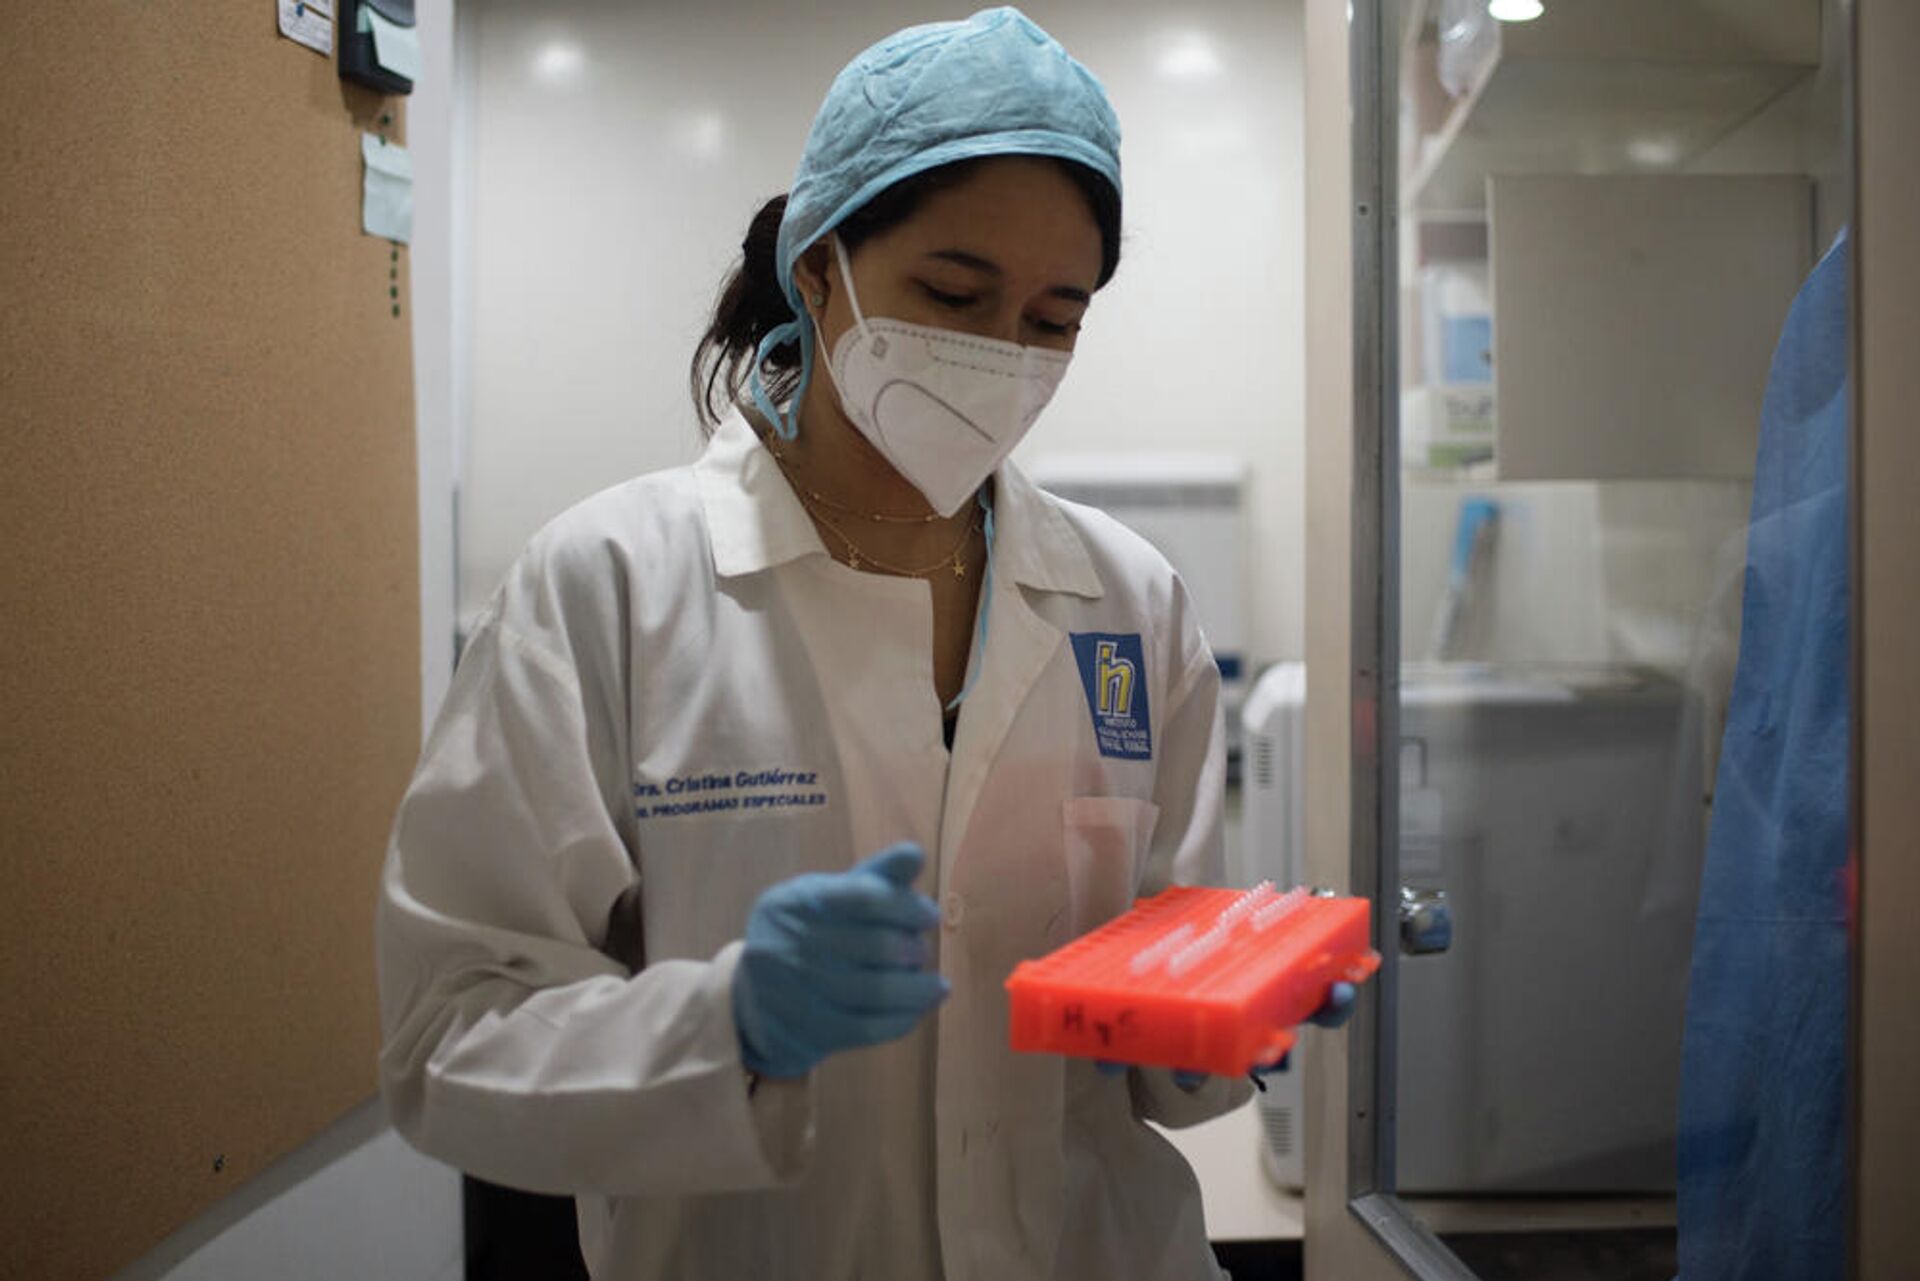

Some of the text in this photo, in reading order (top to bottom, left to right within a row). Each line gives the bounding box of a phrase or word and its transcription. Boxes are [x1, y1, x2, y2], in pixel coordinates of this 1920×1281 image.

[666, 776, 731, 794] Cristina
[736, 768, 816, 787] Gutiérrez
[652, 799, 738, 817] PROGRAMAS
[743, 793, 825, 808] ESPECIALES
